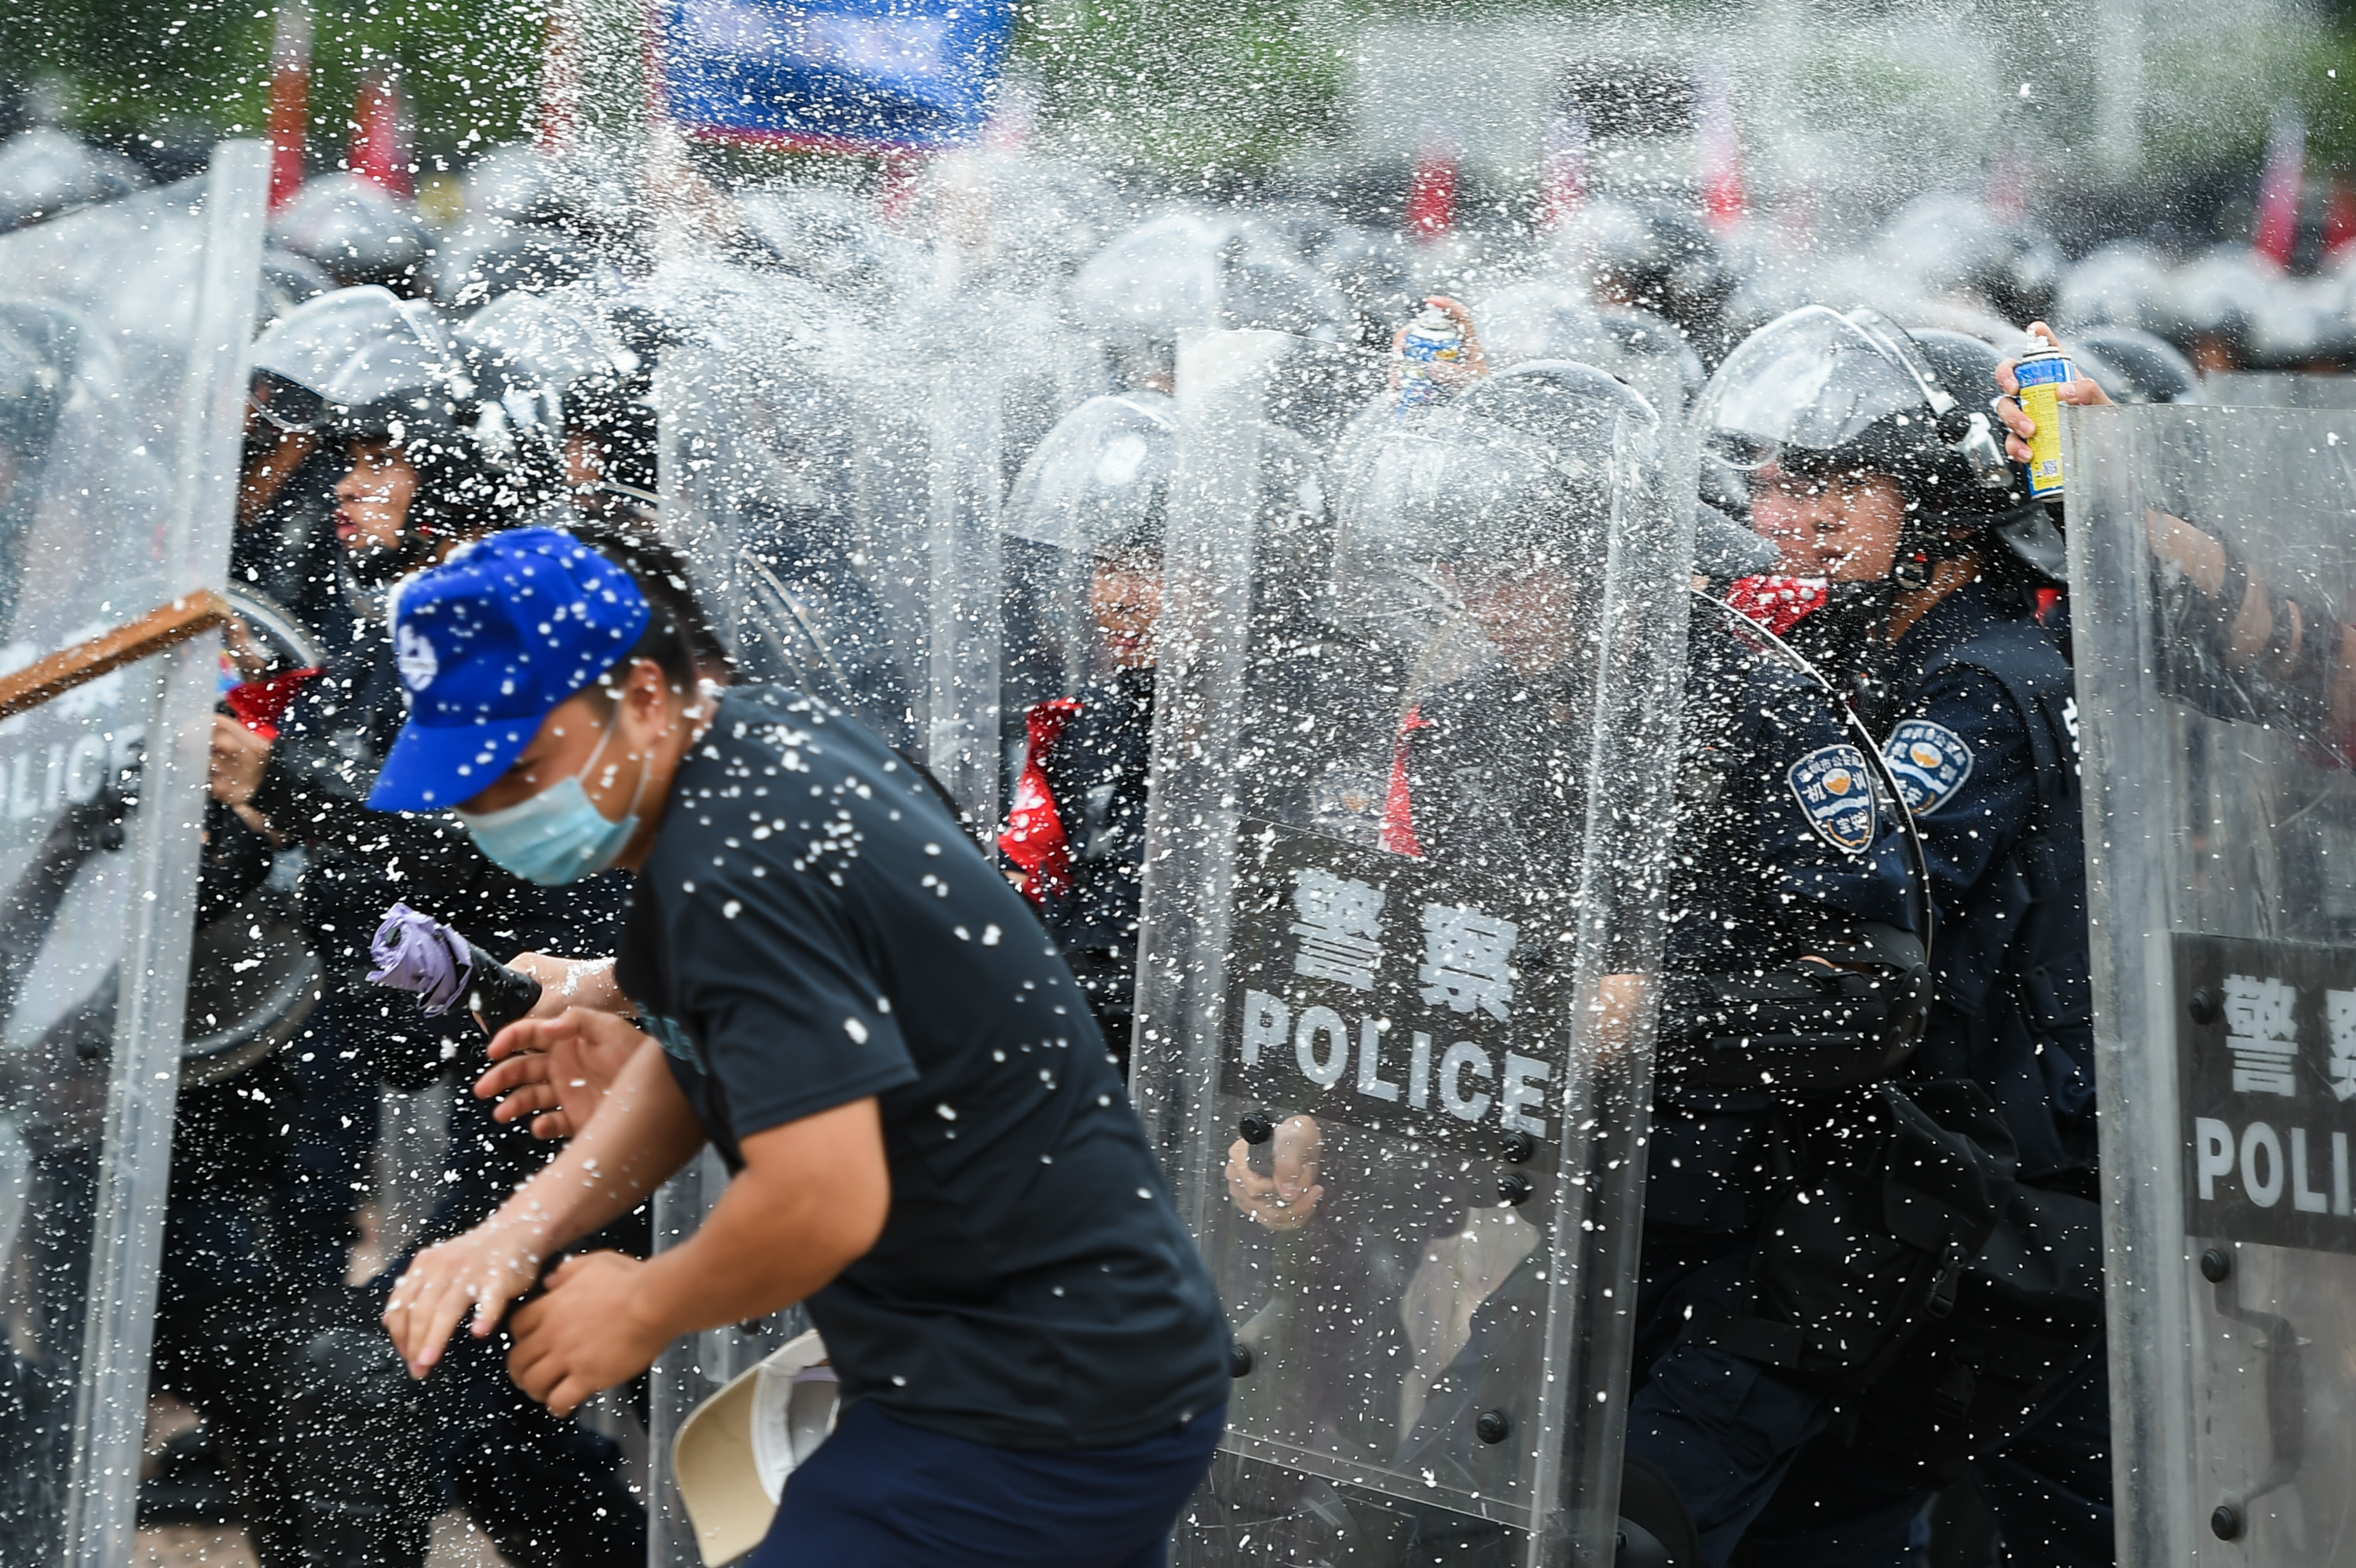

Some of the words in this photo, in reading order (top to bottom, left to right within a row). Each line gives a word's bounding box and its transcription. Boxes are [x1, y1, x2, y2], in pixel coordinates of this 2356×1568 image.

[1289, 867, 1519, 1022] 警察
[1242, 988, 1552, 1139] POLICE
[2196, 1117, 2351, 1216] POLI
